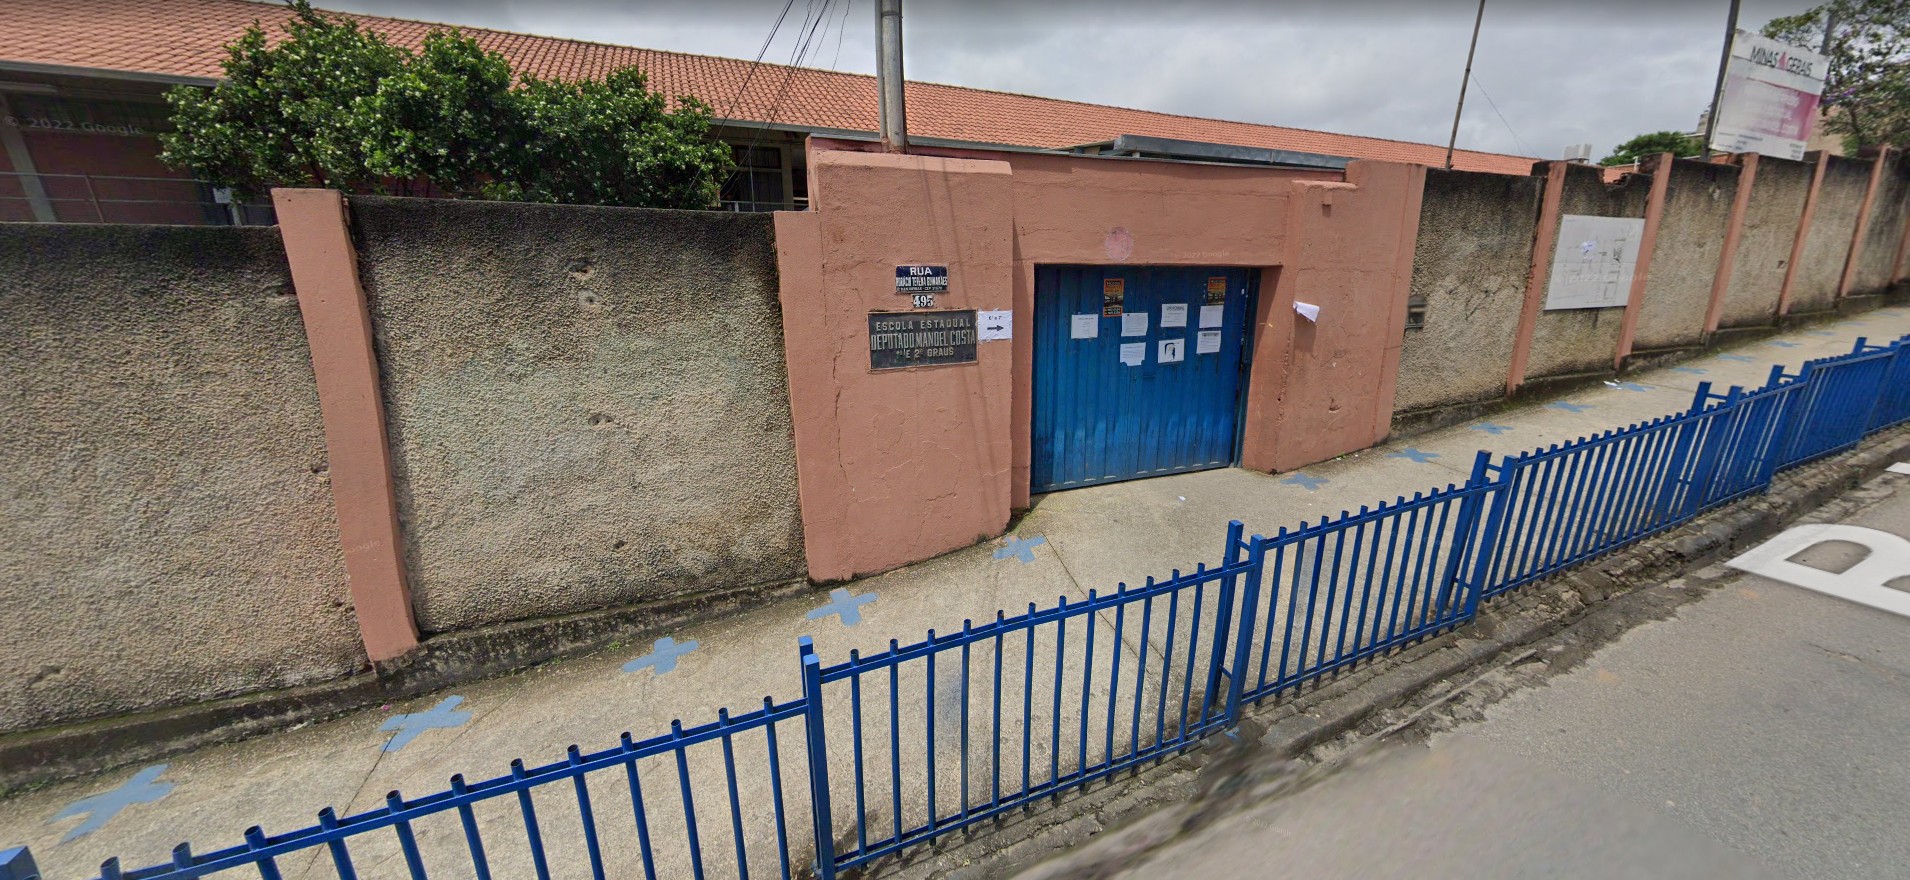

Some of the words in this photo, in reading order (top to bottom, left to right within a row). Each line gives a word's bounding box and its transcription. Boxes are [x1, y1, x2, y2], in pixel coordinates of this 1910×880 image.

[1750, 46, 1778, 68] MINAS
[910, 267, 932, 276] RUA
[913, 295, 934, 308] 495
[876, 321, 914, 331] ESCOLA
[920, 319, 971, 329] ESTADUAL
[870, 332, 915, 351] DEPUTADO
[916, 331, 949, 348] MANOEL
[950, 330, 976, 346] COSTA
[927, 347, 954, 357] GRAUS
